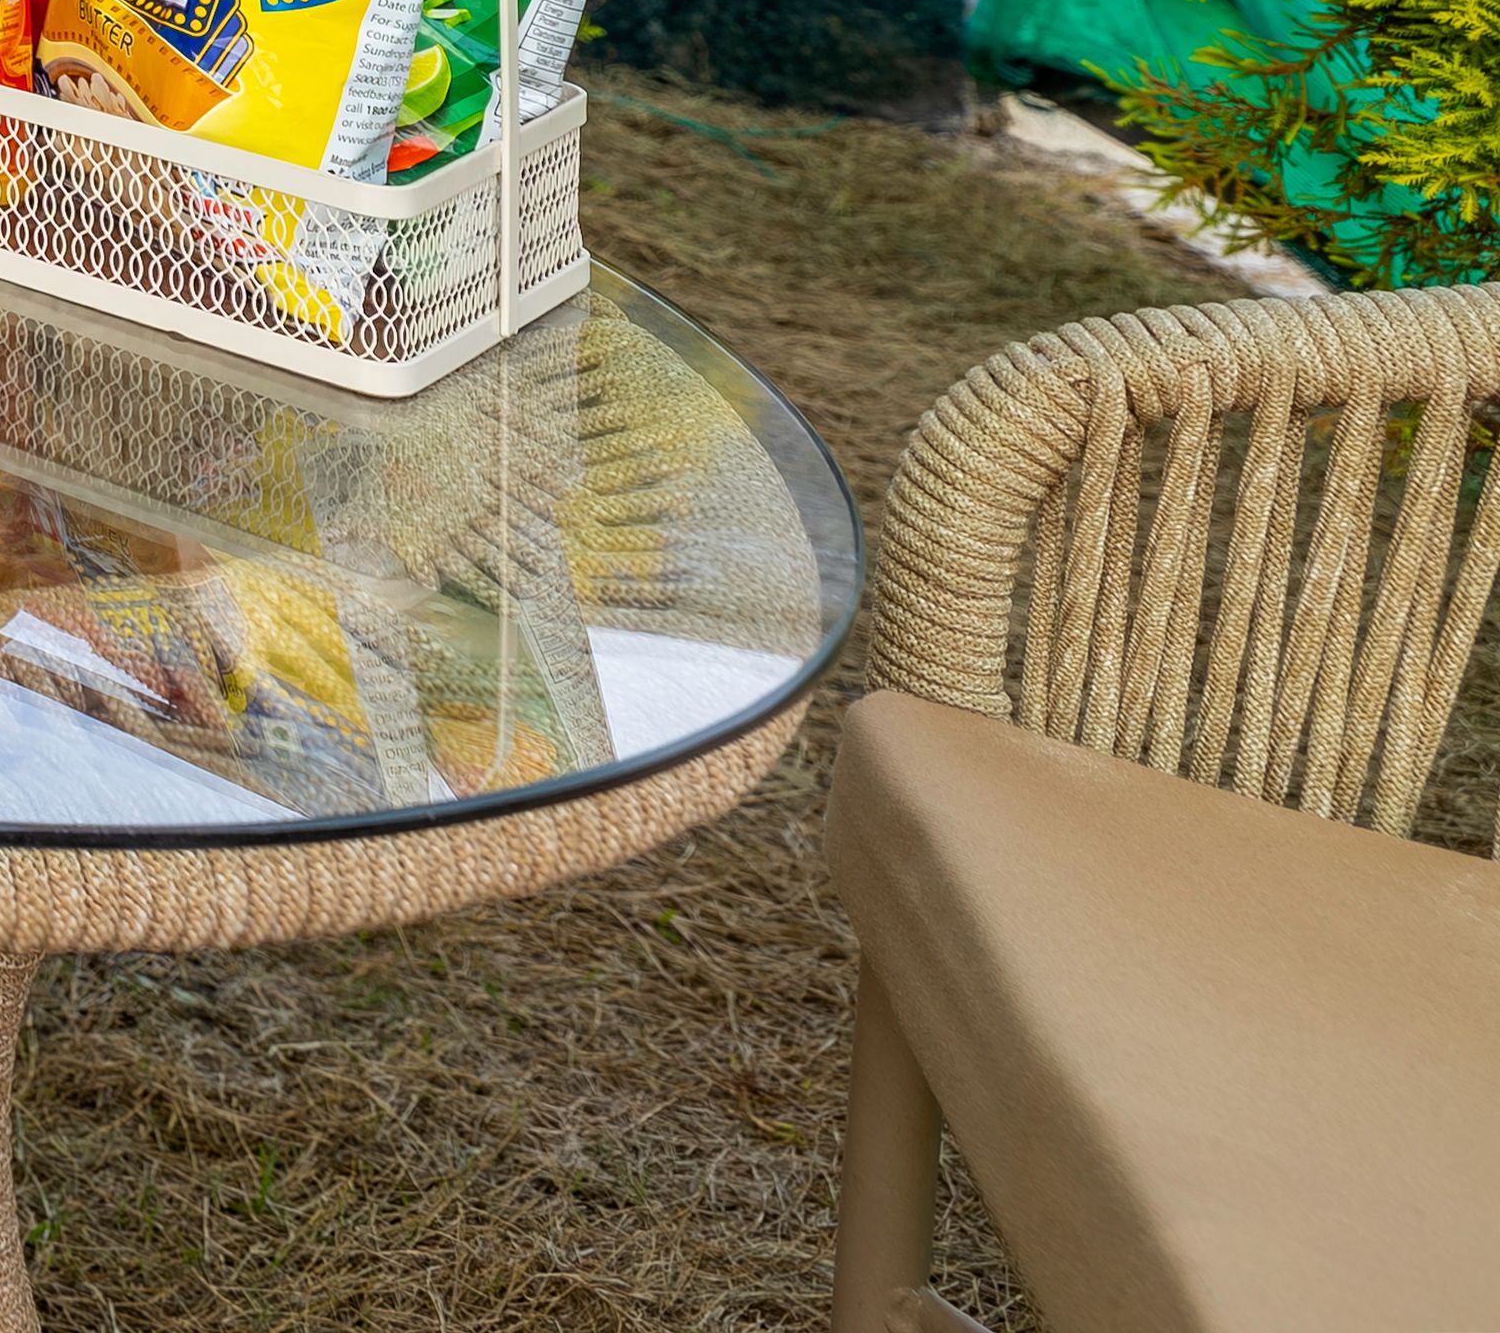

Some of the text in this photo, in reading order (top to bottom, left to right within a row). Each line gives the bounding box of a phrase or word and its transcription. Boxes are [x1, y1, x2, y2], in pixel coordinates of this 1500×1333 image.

[370, 13, 391, 27] For
[345, 102, 363, 114] call
[341, 119, 353, 129] or
